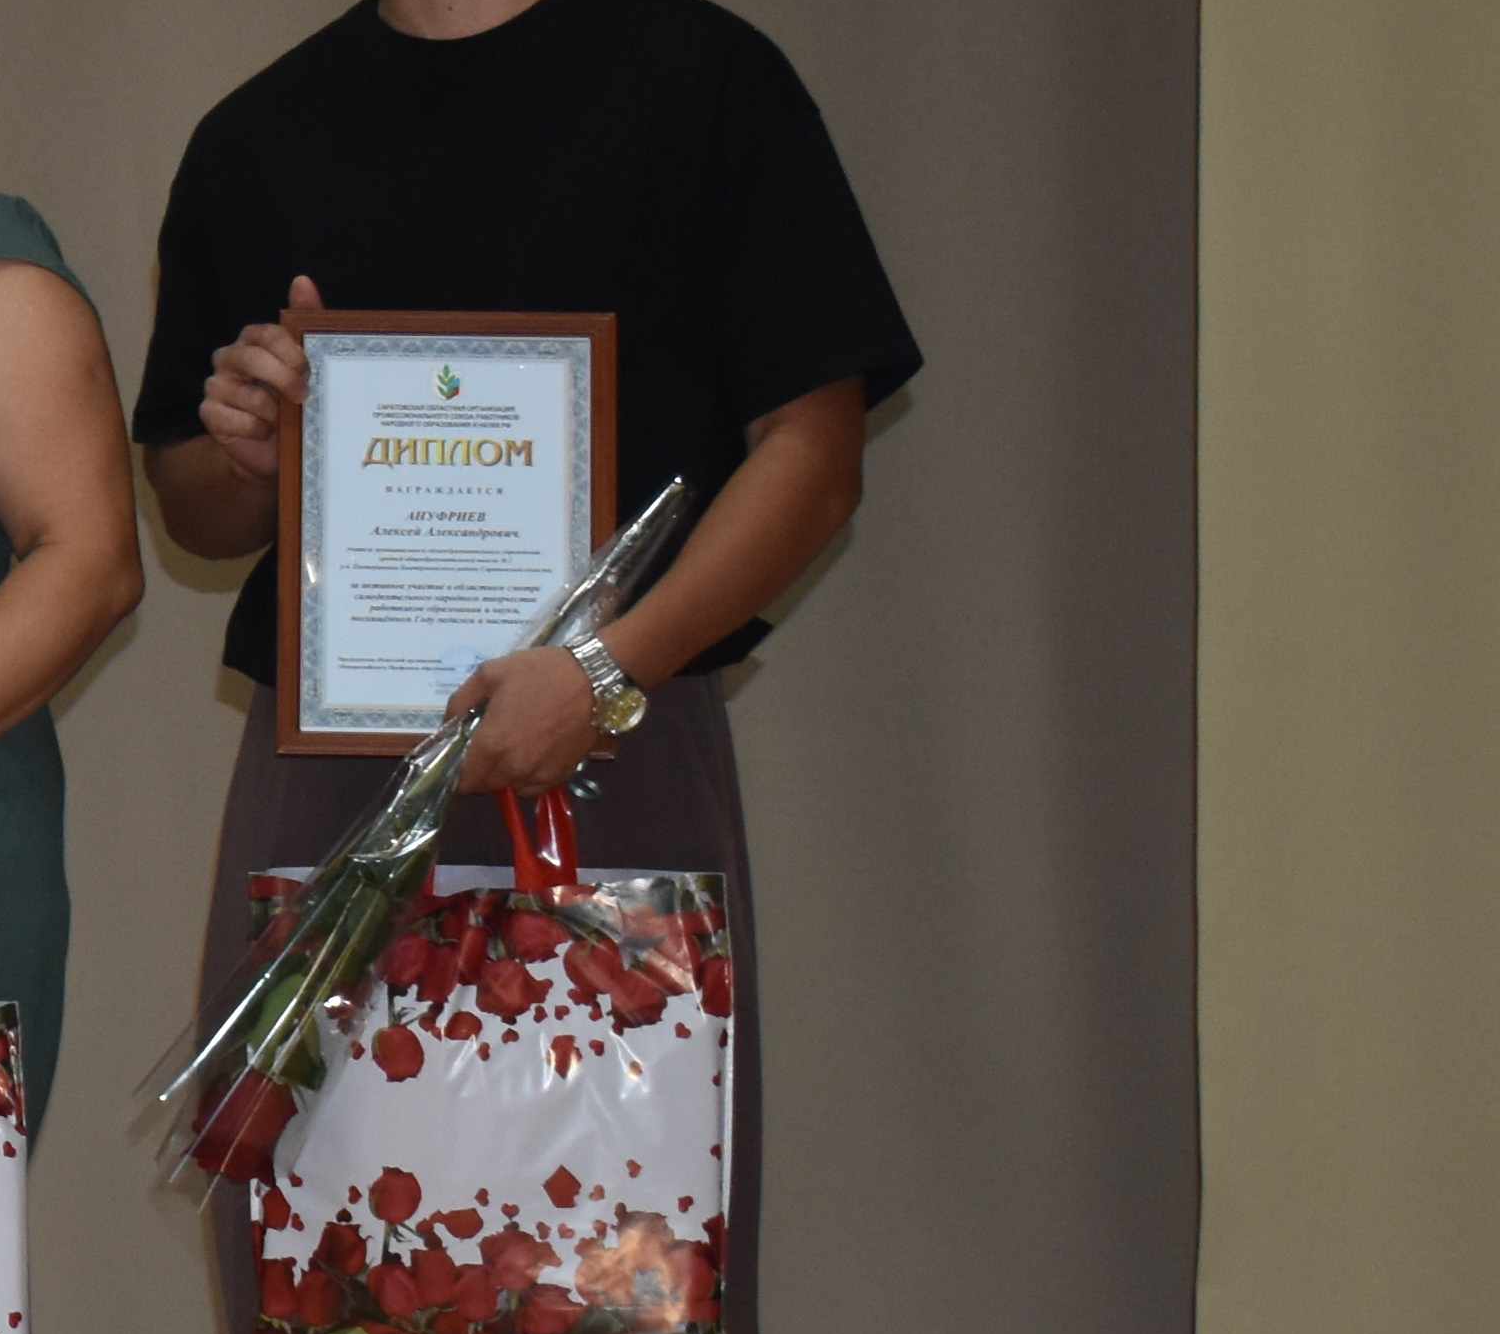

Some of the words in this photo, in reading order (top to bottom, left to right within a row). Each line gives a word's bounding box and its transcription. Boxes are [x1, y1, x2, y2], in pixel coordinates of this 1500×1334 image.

[362, 436, 534, 468] ДИПЛОМ
[408, 511, 486, 521] АНУФРИЕВ
[370, 526, 421, 536] Алексей
[426, 527, 519, 539] Александрович
